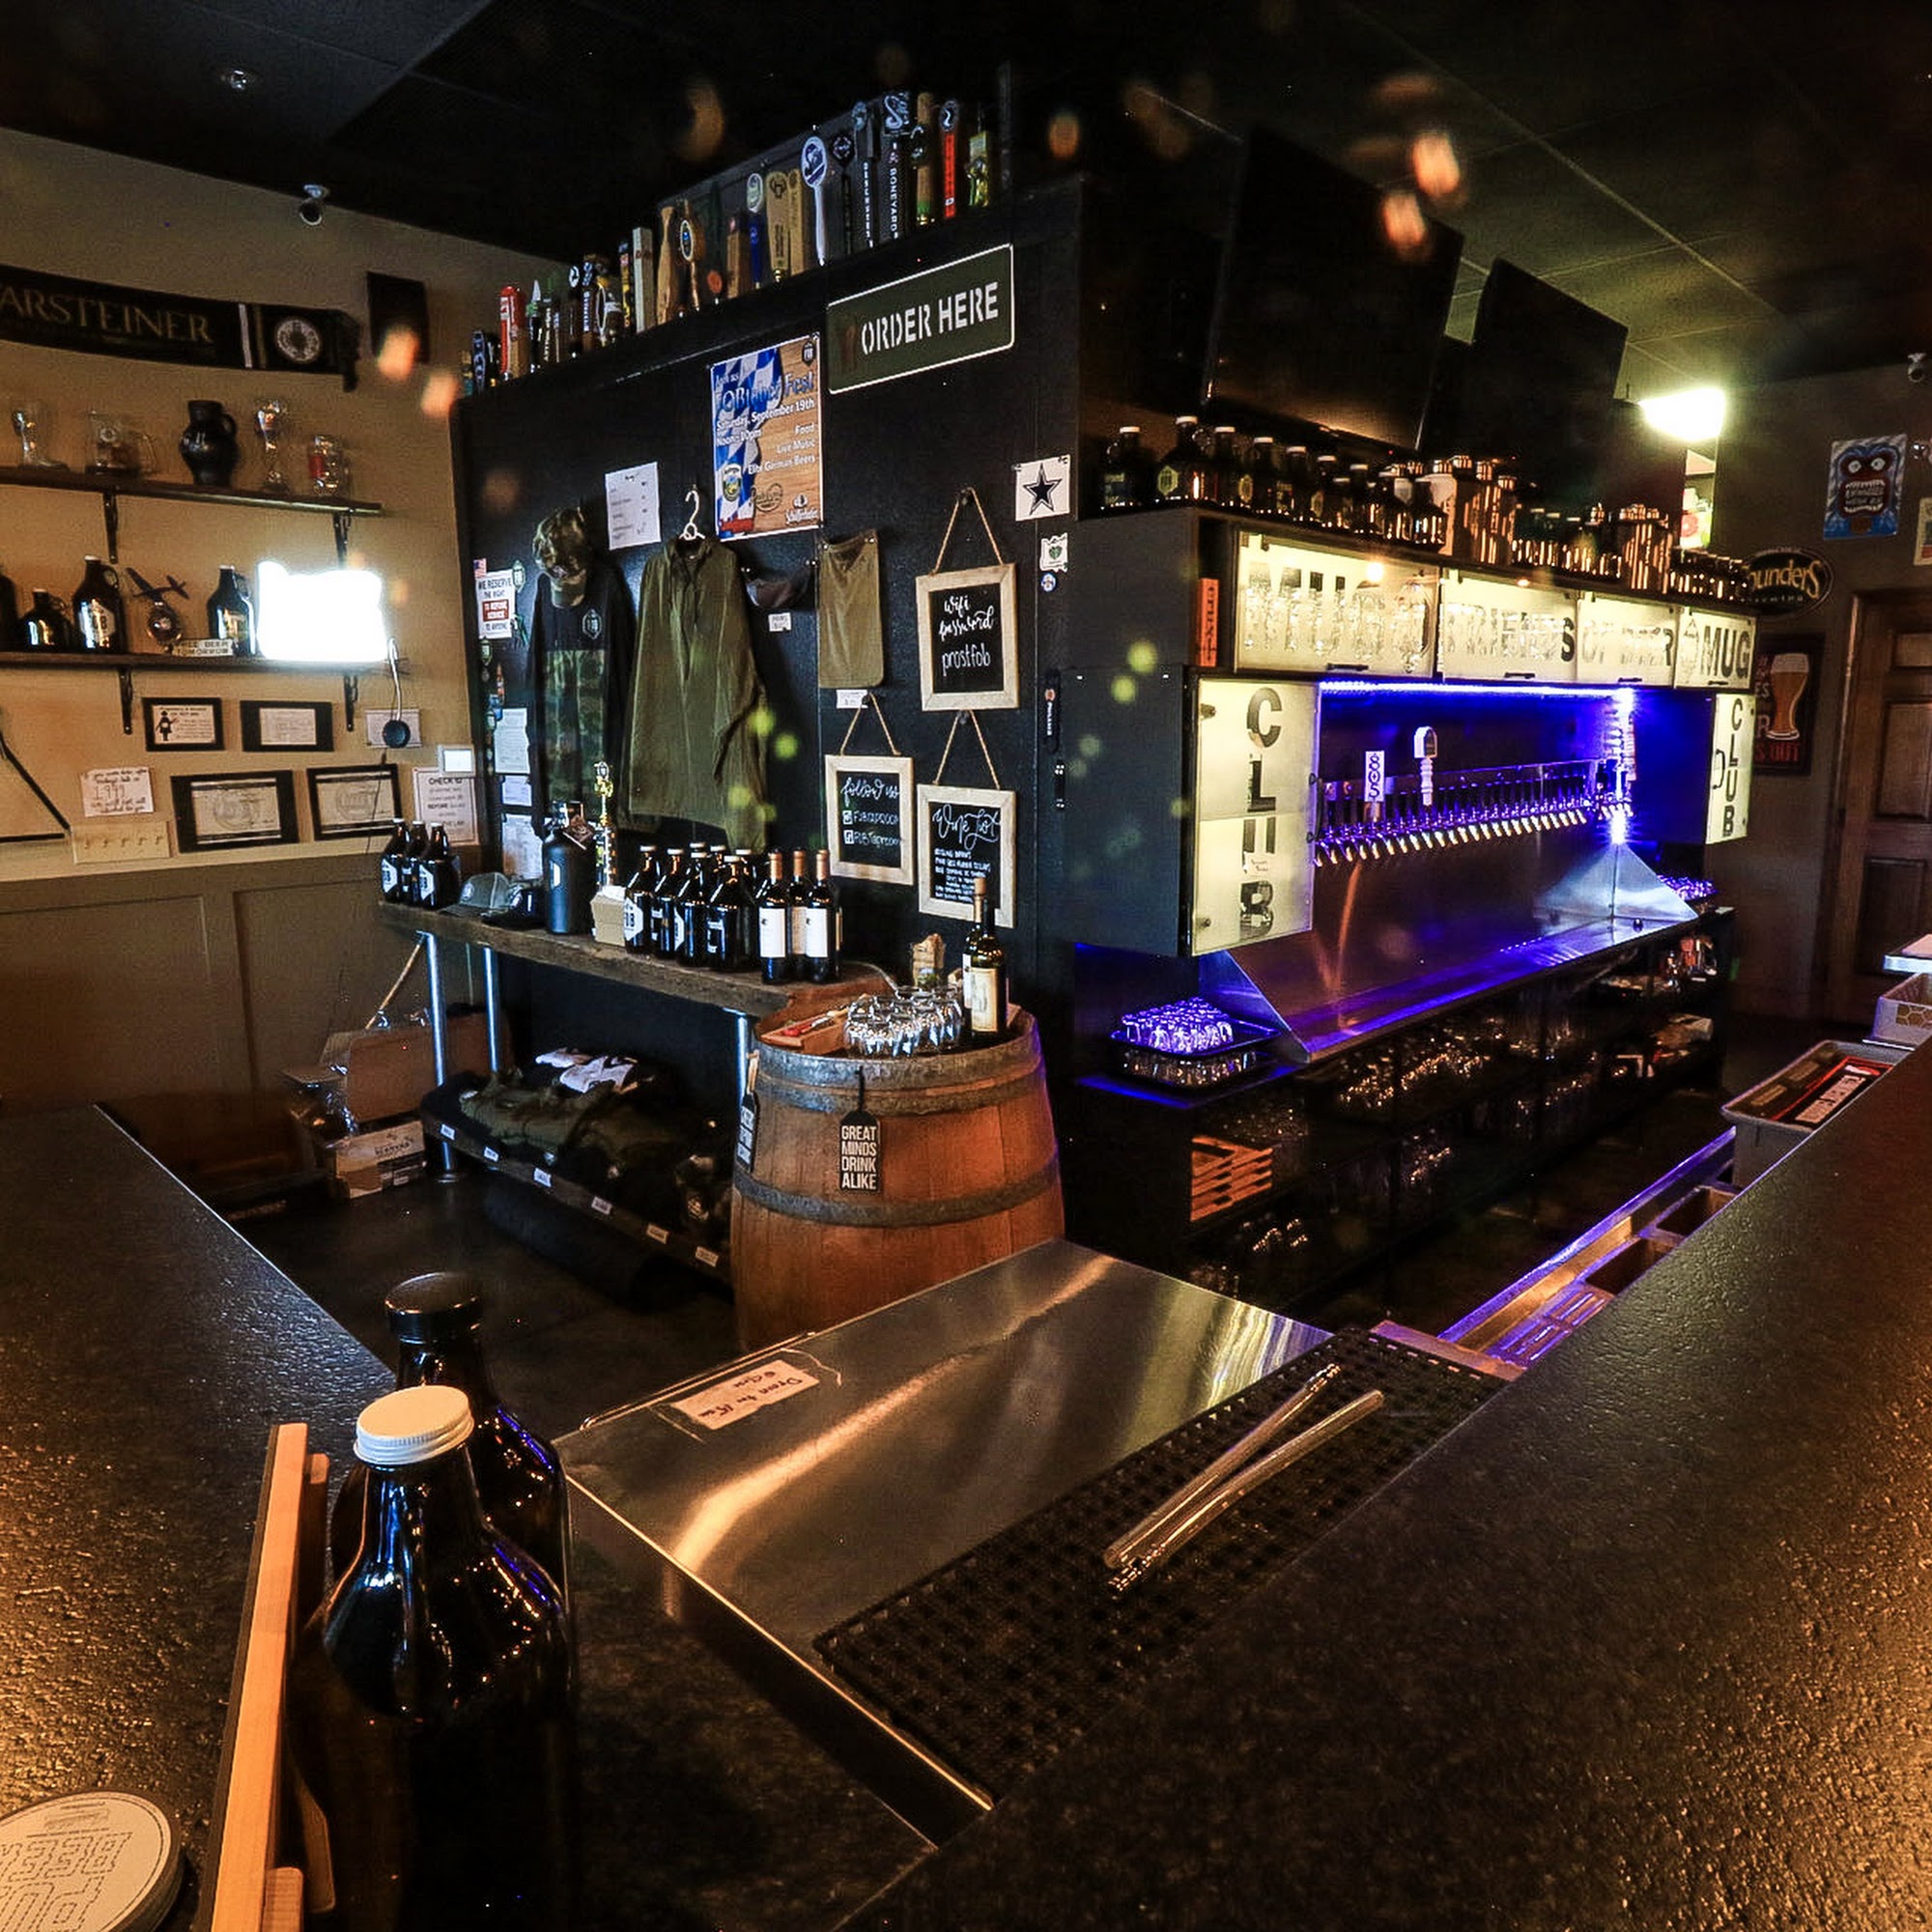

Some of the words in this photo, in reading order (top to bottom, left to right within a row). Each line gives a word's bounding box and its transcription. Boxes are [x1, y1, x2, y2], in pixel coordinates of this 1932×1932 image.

[889, 167, 897, 233] BONEYARD
[0, 281, 213, 344] ARSTEINER
[861, 303, 932, 355] ORDER
[938, 281, 999, 334] HERE
[752, 404, 794, 422] September
[795, 397, 815, 412] 19th
[795, 422, 815, 435] Food
[793, 439, 816, 450] Music
[794, 454, 816, 467] Beers
[943, 594, 970, 618] wifi
[939, 606, 994, 642] password
[942, 642, 991, 677] prostfob
[1700, 624, 1751, 679] MUG
[1722, 697, 1743, 838] CLUB
[840, 777, 885, 808] follow
[841, 1125, 877, 1141] GREAT
[841, 1141, 877, 1156] MINDS
[841, 1156, 877, 1173] DRINK
[841, 1172, 877, 1190] ALIKE
